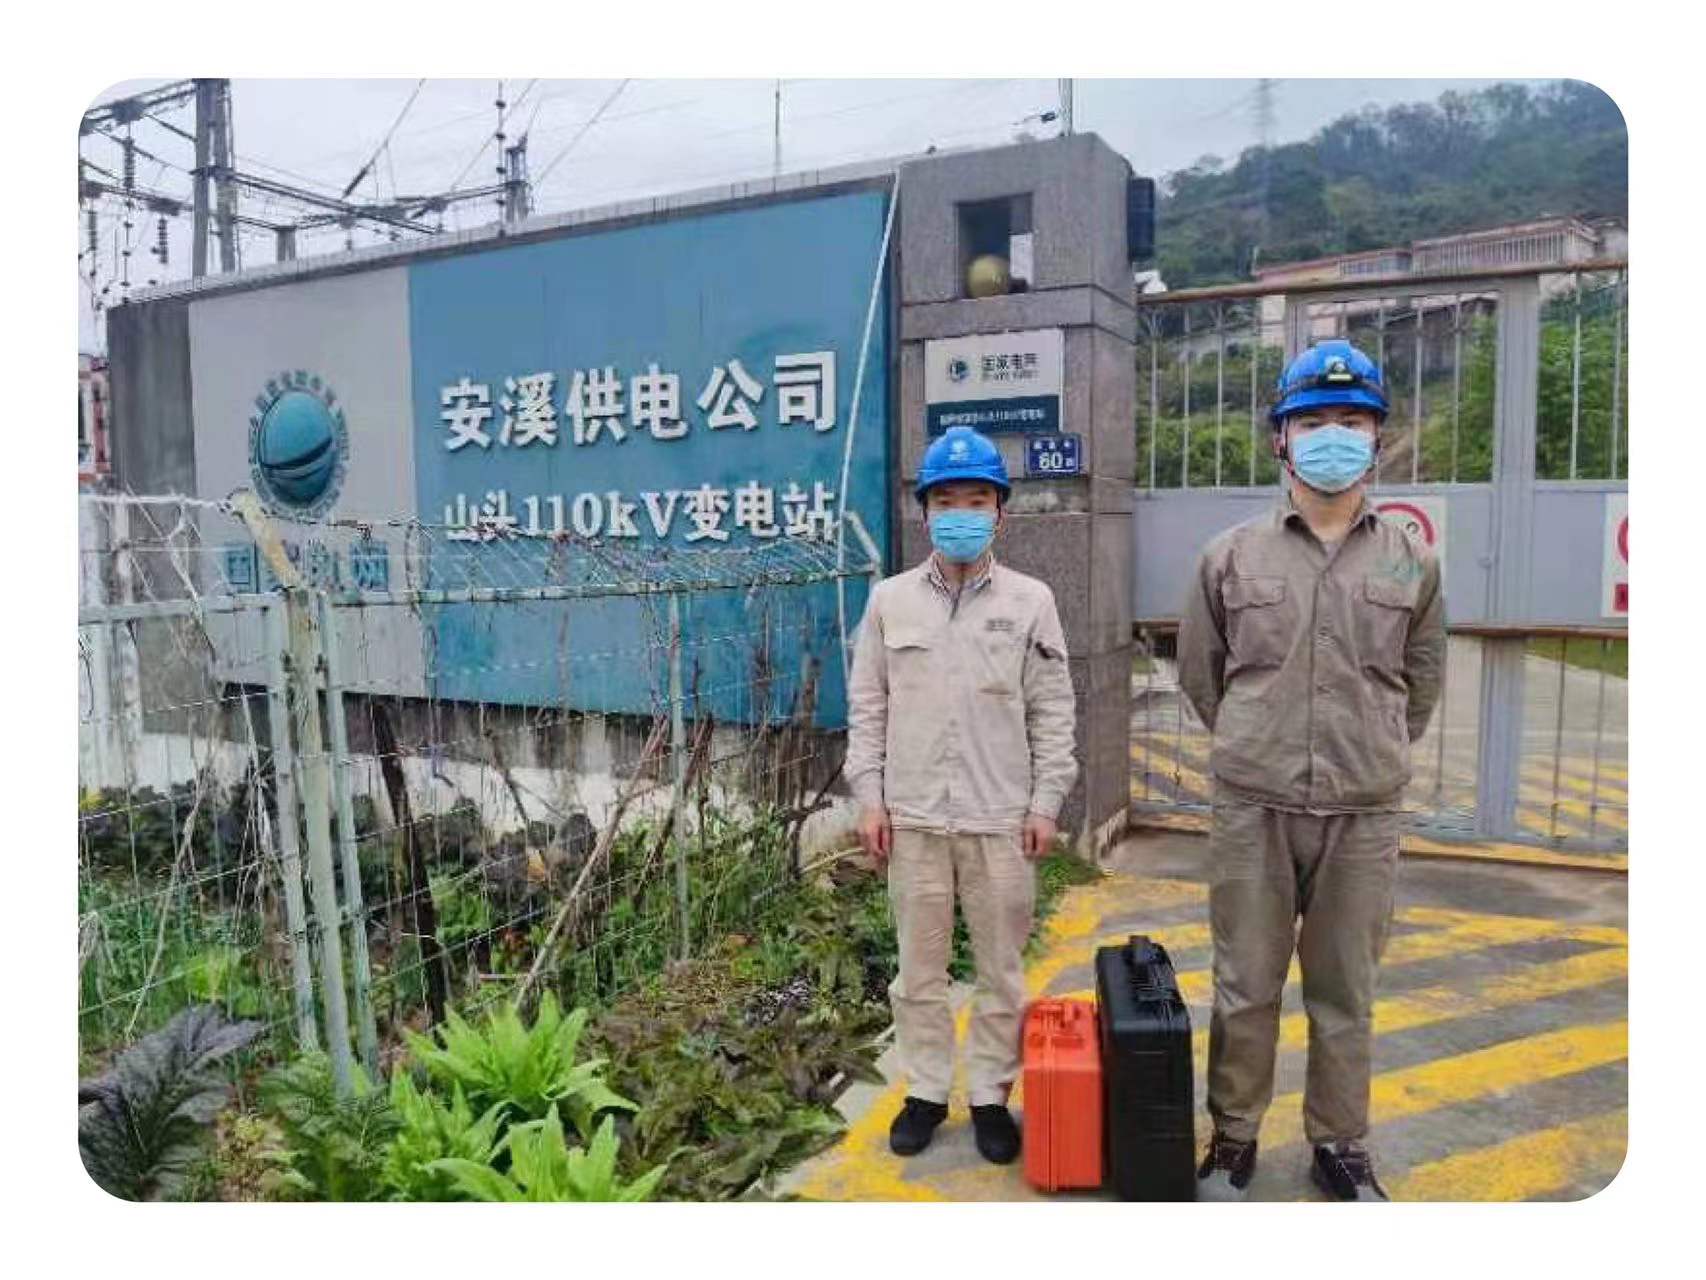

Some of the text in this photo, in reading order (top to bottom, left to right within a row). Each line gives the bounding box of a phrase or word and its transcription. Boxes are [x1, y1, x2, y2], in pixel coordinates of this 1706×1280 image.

[440, 350, 838, 452] 安溪供电公司
[443, 481, 840, 544] 山头110kV变电站
